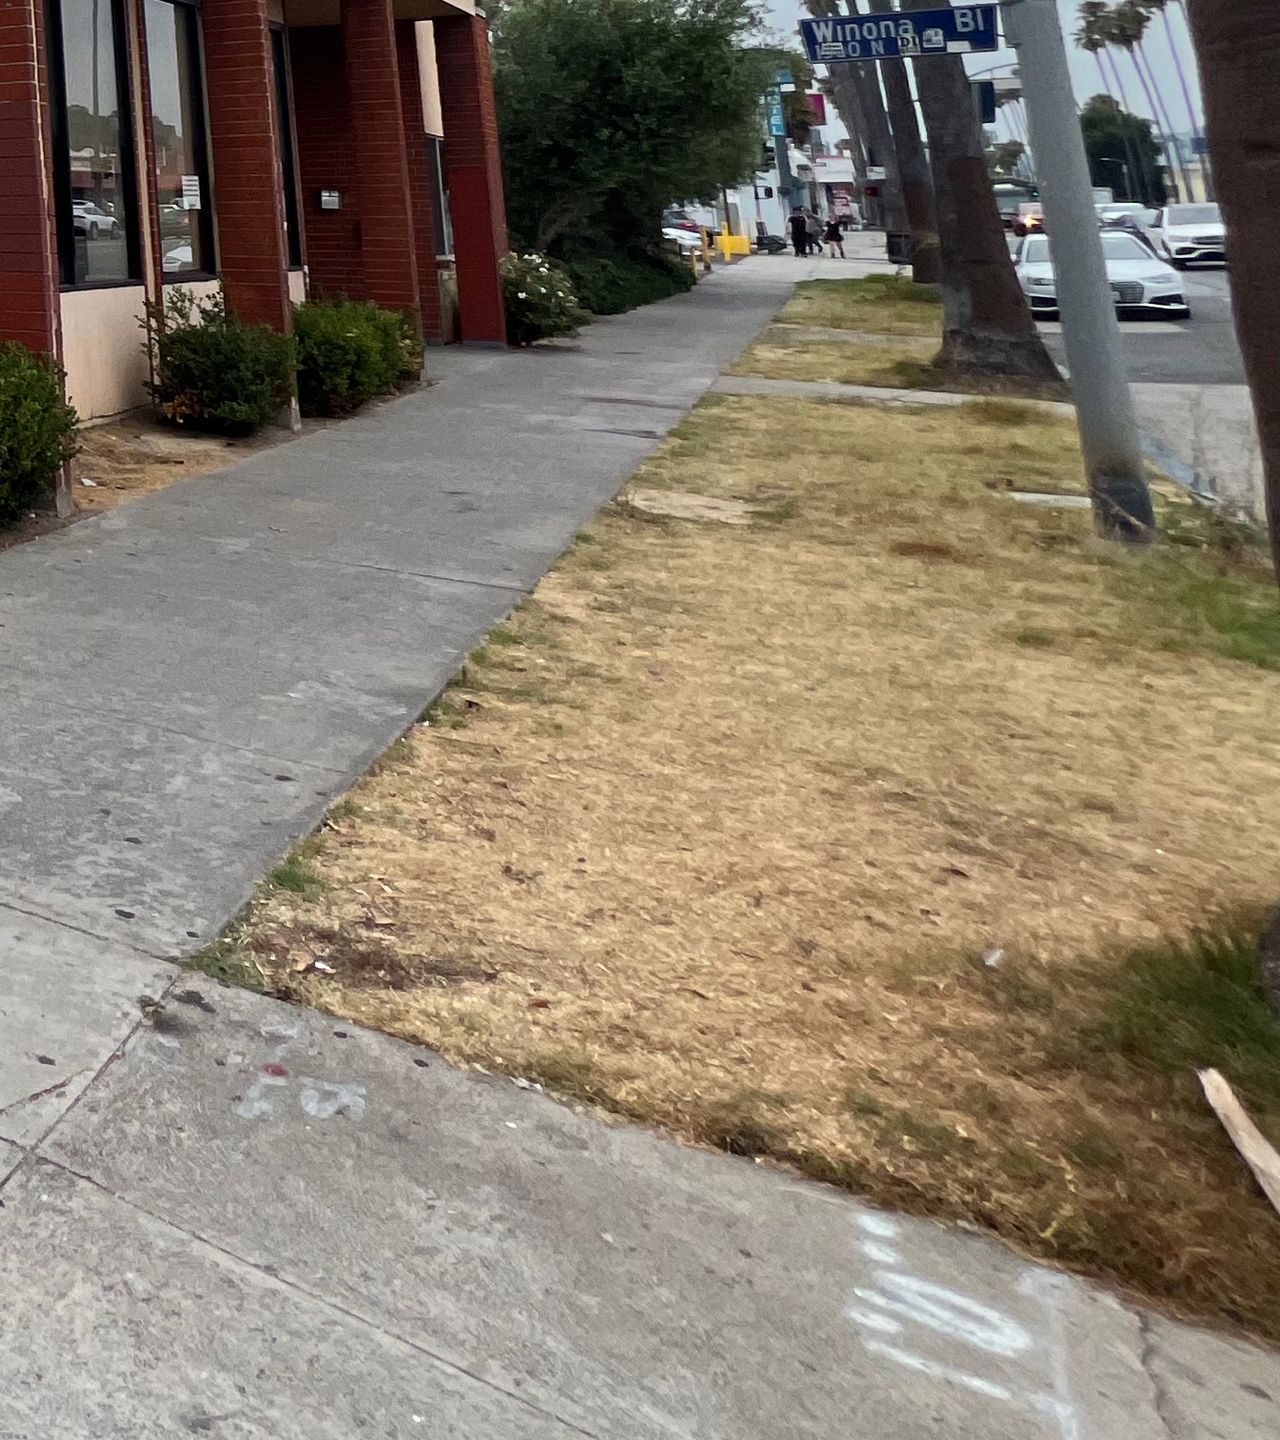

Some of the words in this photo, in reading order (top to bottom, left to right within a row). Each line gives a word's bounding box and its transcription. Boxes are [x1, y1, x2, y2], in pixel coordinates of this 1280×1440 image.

[811, 19, 914, 43] Winona
[954, 8, 985, 33] Bl
[871, 39, 886, 56] N
